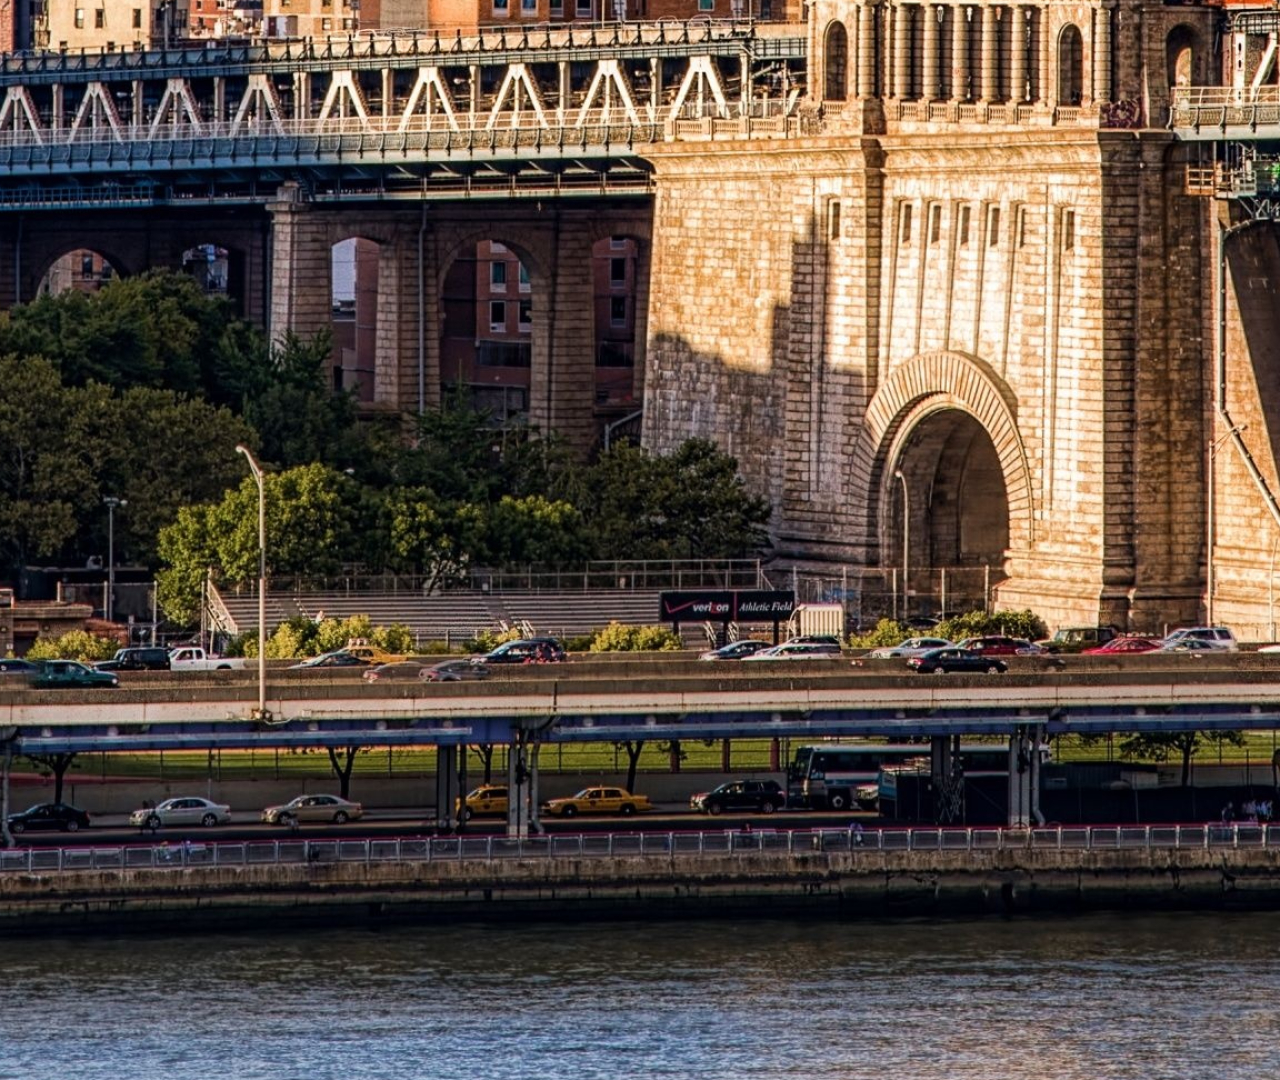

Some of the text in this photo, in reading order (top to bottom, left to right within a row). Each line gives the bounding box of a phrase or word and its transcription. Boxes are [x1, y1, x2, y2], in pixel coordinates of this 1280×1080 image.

[692, 601, 793, 614] verizon Athletic Field
